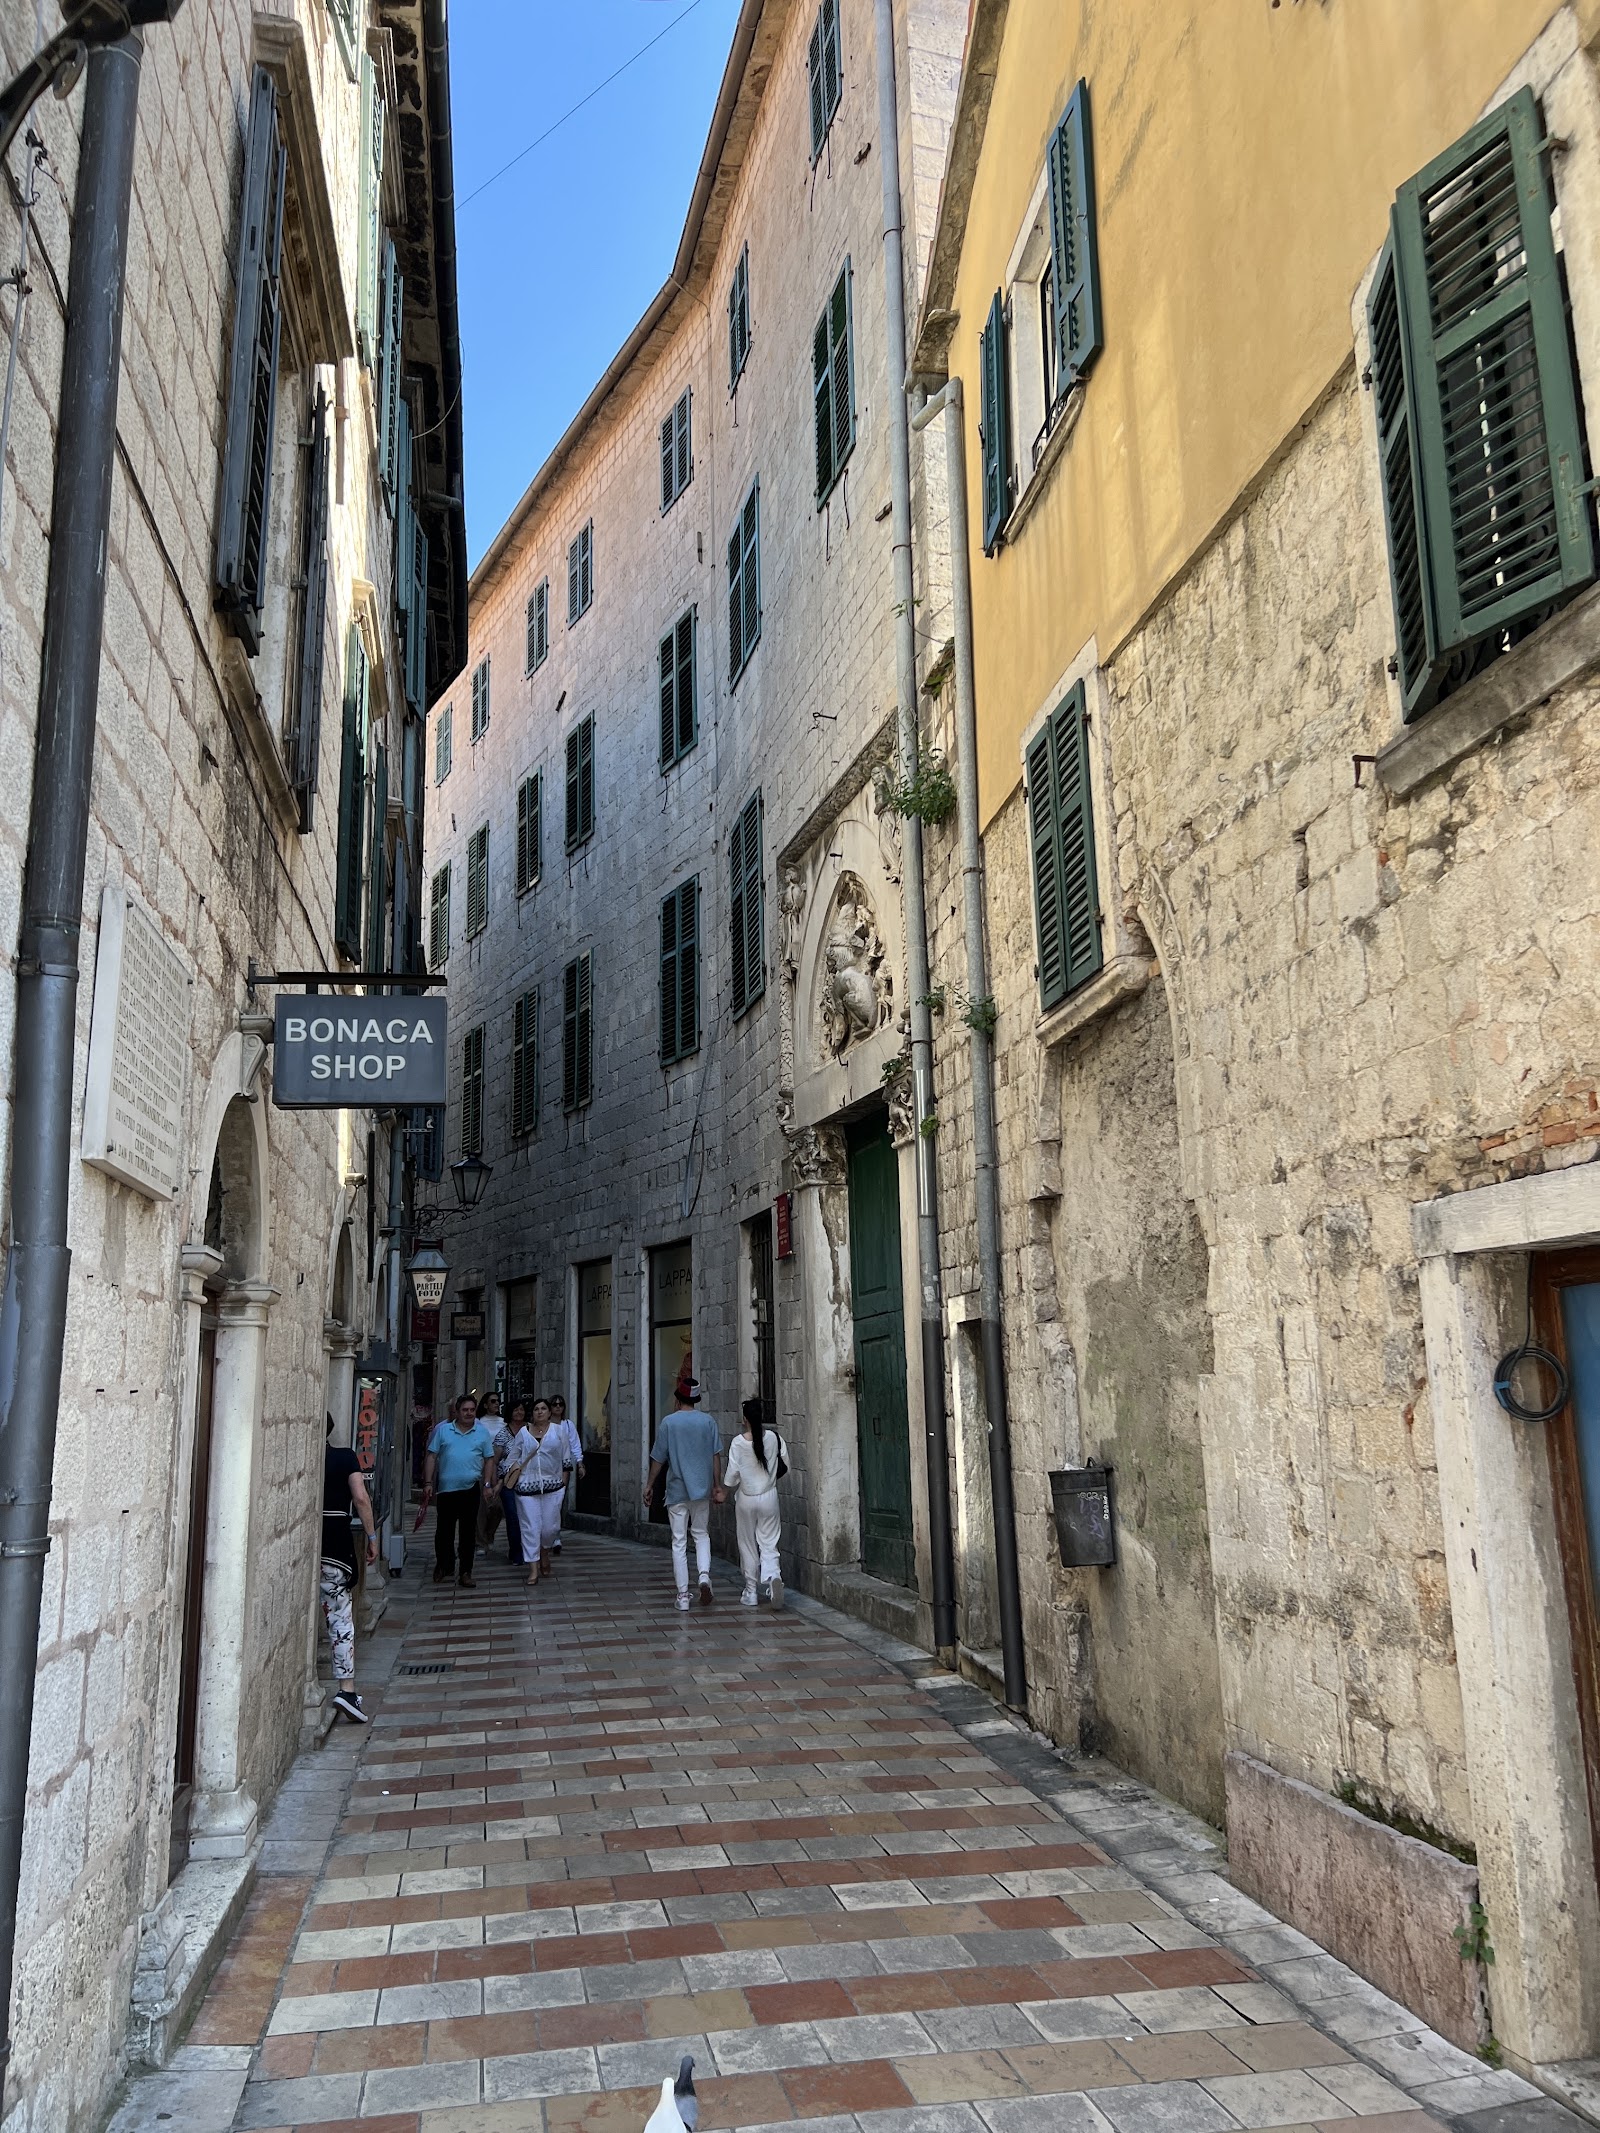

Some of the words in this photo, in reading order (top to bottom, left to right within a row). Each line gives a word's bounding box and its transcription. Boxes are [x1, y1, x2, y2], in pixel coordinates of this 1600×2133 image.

[285, 1016, 434, 1044] BONACA
[310, 1054, 407, 1080] SHOP
[358, 1389, 378, 1470] FOTO
